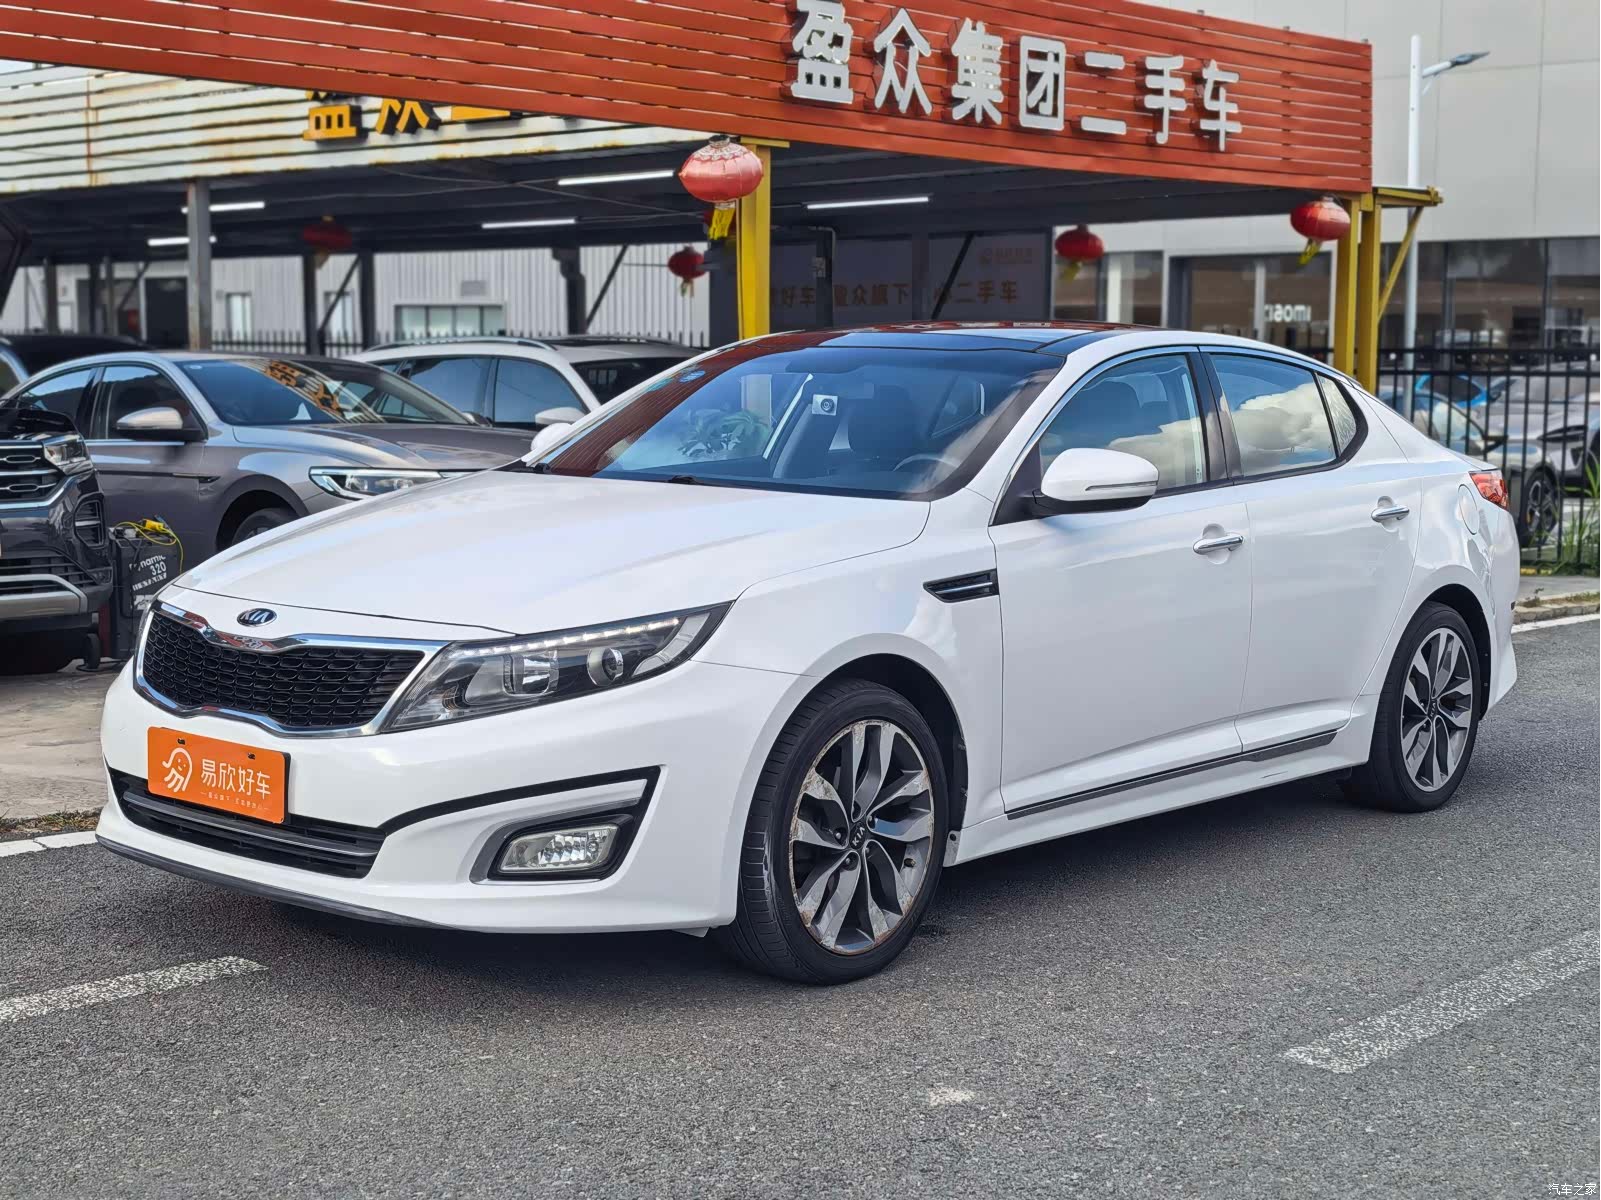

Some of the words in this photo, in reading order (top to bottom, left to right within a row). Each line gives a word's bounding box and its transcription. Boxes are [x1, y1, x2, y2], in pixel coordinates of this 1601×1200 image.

[791, 0, 1242, 151] 盈众集团二手车
[150, 562, 167, 576] 320
[239, 609, 272, 624] KIA
[200, 758, 271, 800] 易欣好车
[851, 826, 866, 847] KIA
